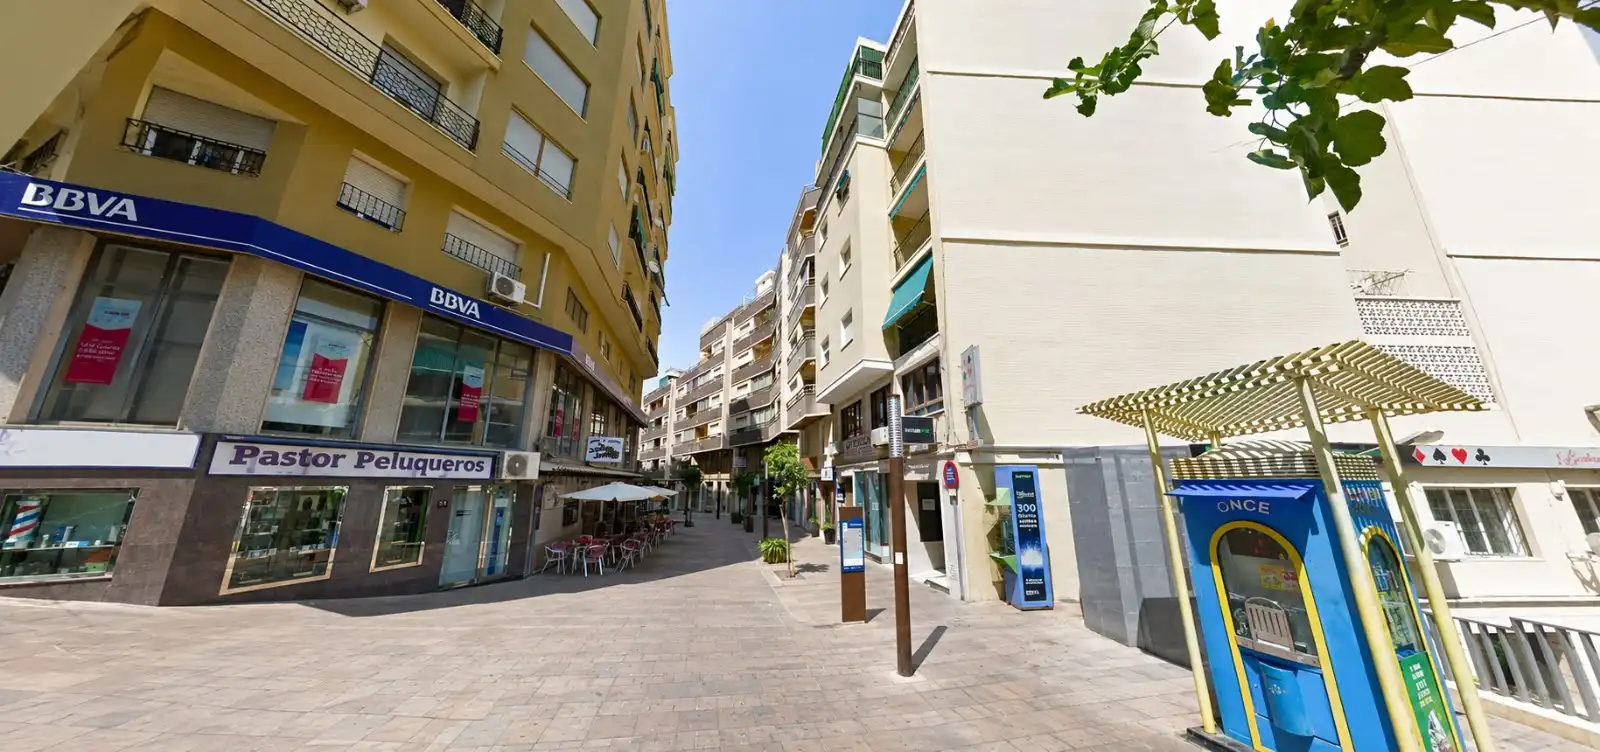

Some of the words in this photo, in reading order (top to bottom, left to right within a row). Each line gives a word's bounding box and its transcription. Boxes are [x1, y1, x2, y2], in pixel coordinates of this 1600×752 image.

[21, 182, 138, 221] BBVA
[430, 287, 480, 319] BBVA
[229, 444, 349, 468] Pastor
[353, 450, 485, 476] Peluqueros
[1016, 503, 1036, 513] 300
[1217, 499, 1270, 514] ONCE
